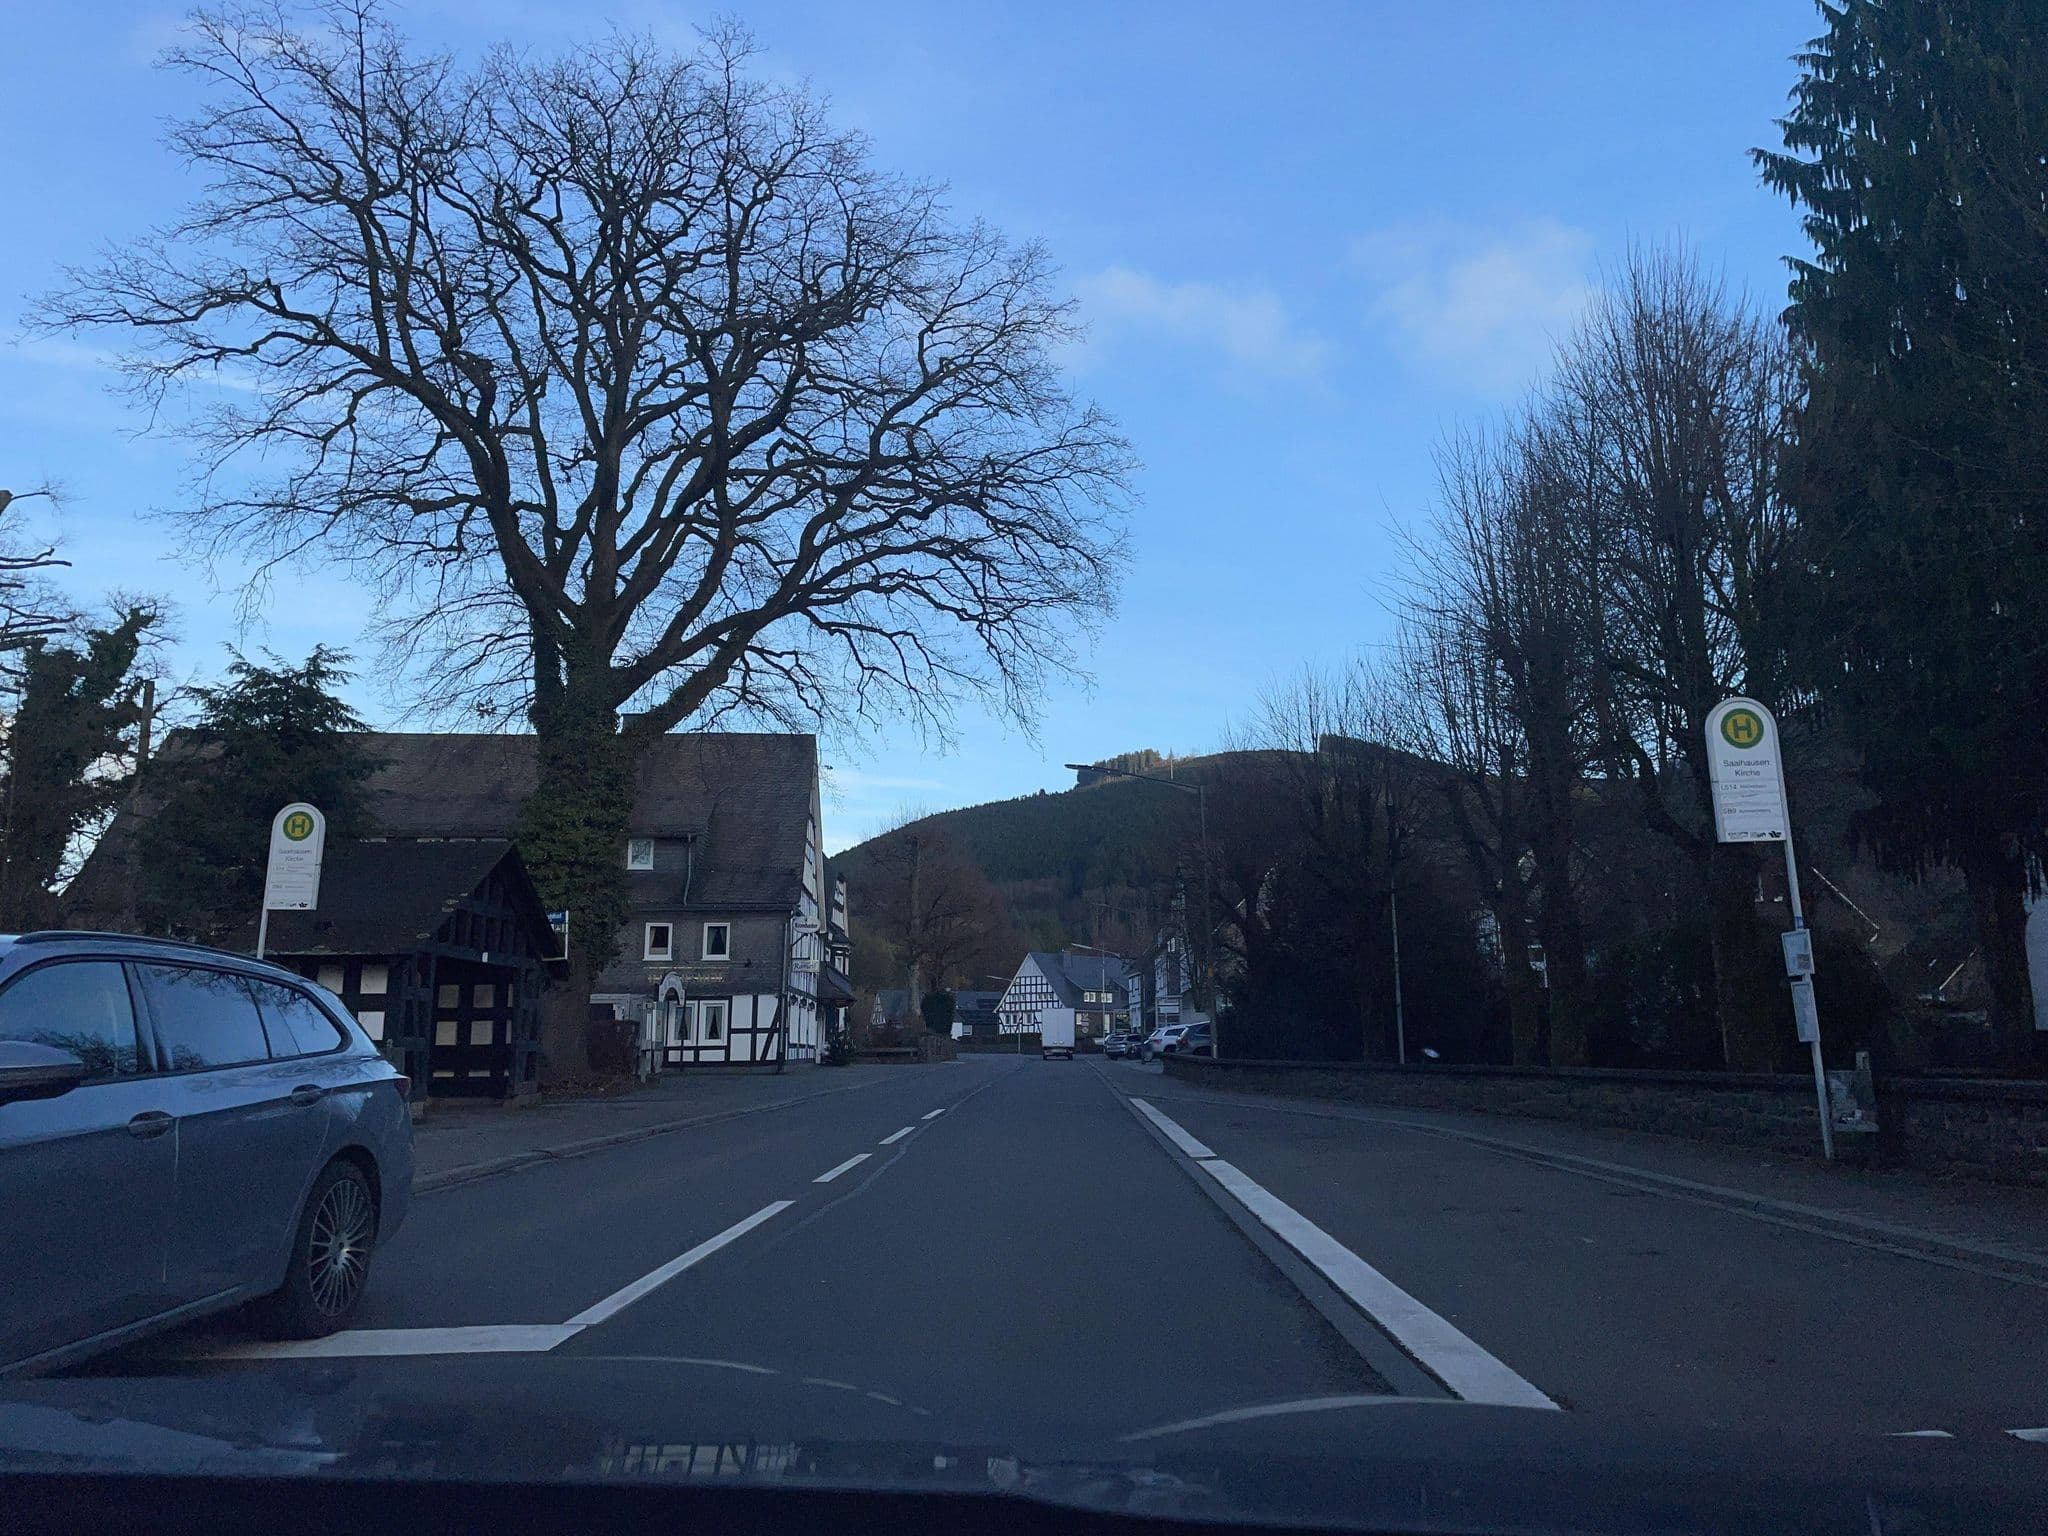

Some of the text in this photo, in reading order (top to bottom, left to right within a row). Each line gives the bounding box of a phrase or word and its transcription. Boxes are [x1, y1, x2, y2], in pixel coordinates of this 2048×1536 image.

[1732, 718, 1752, 738] H
[1723, 759, 1770, 767] Saalhausen
[1735, 769, 1761, 777] Kirche
[292, 819, 305, 834] H
